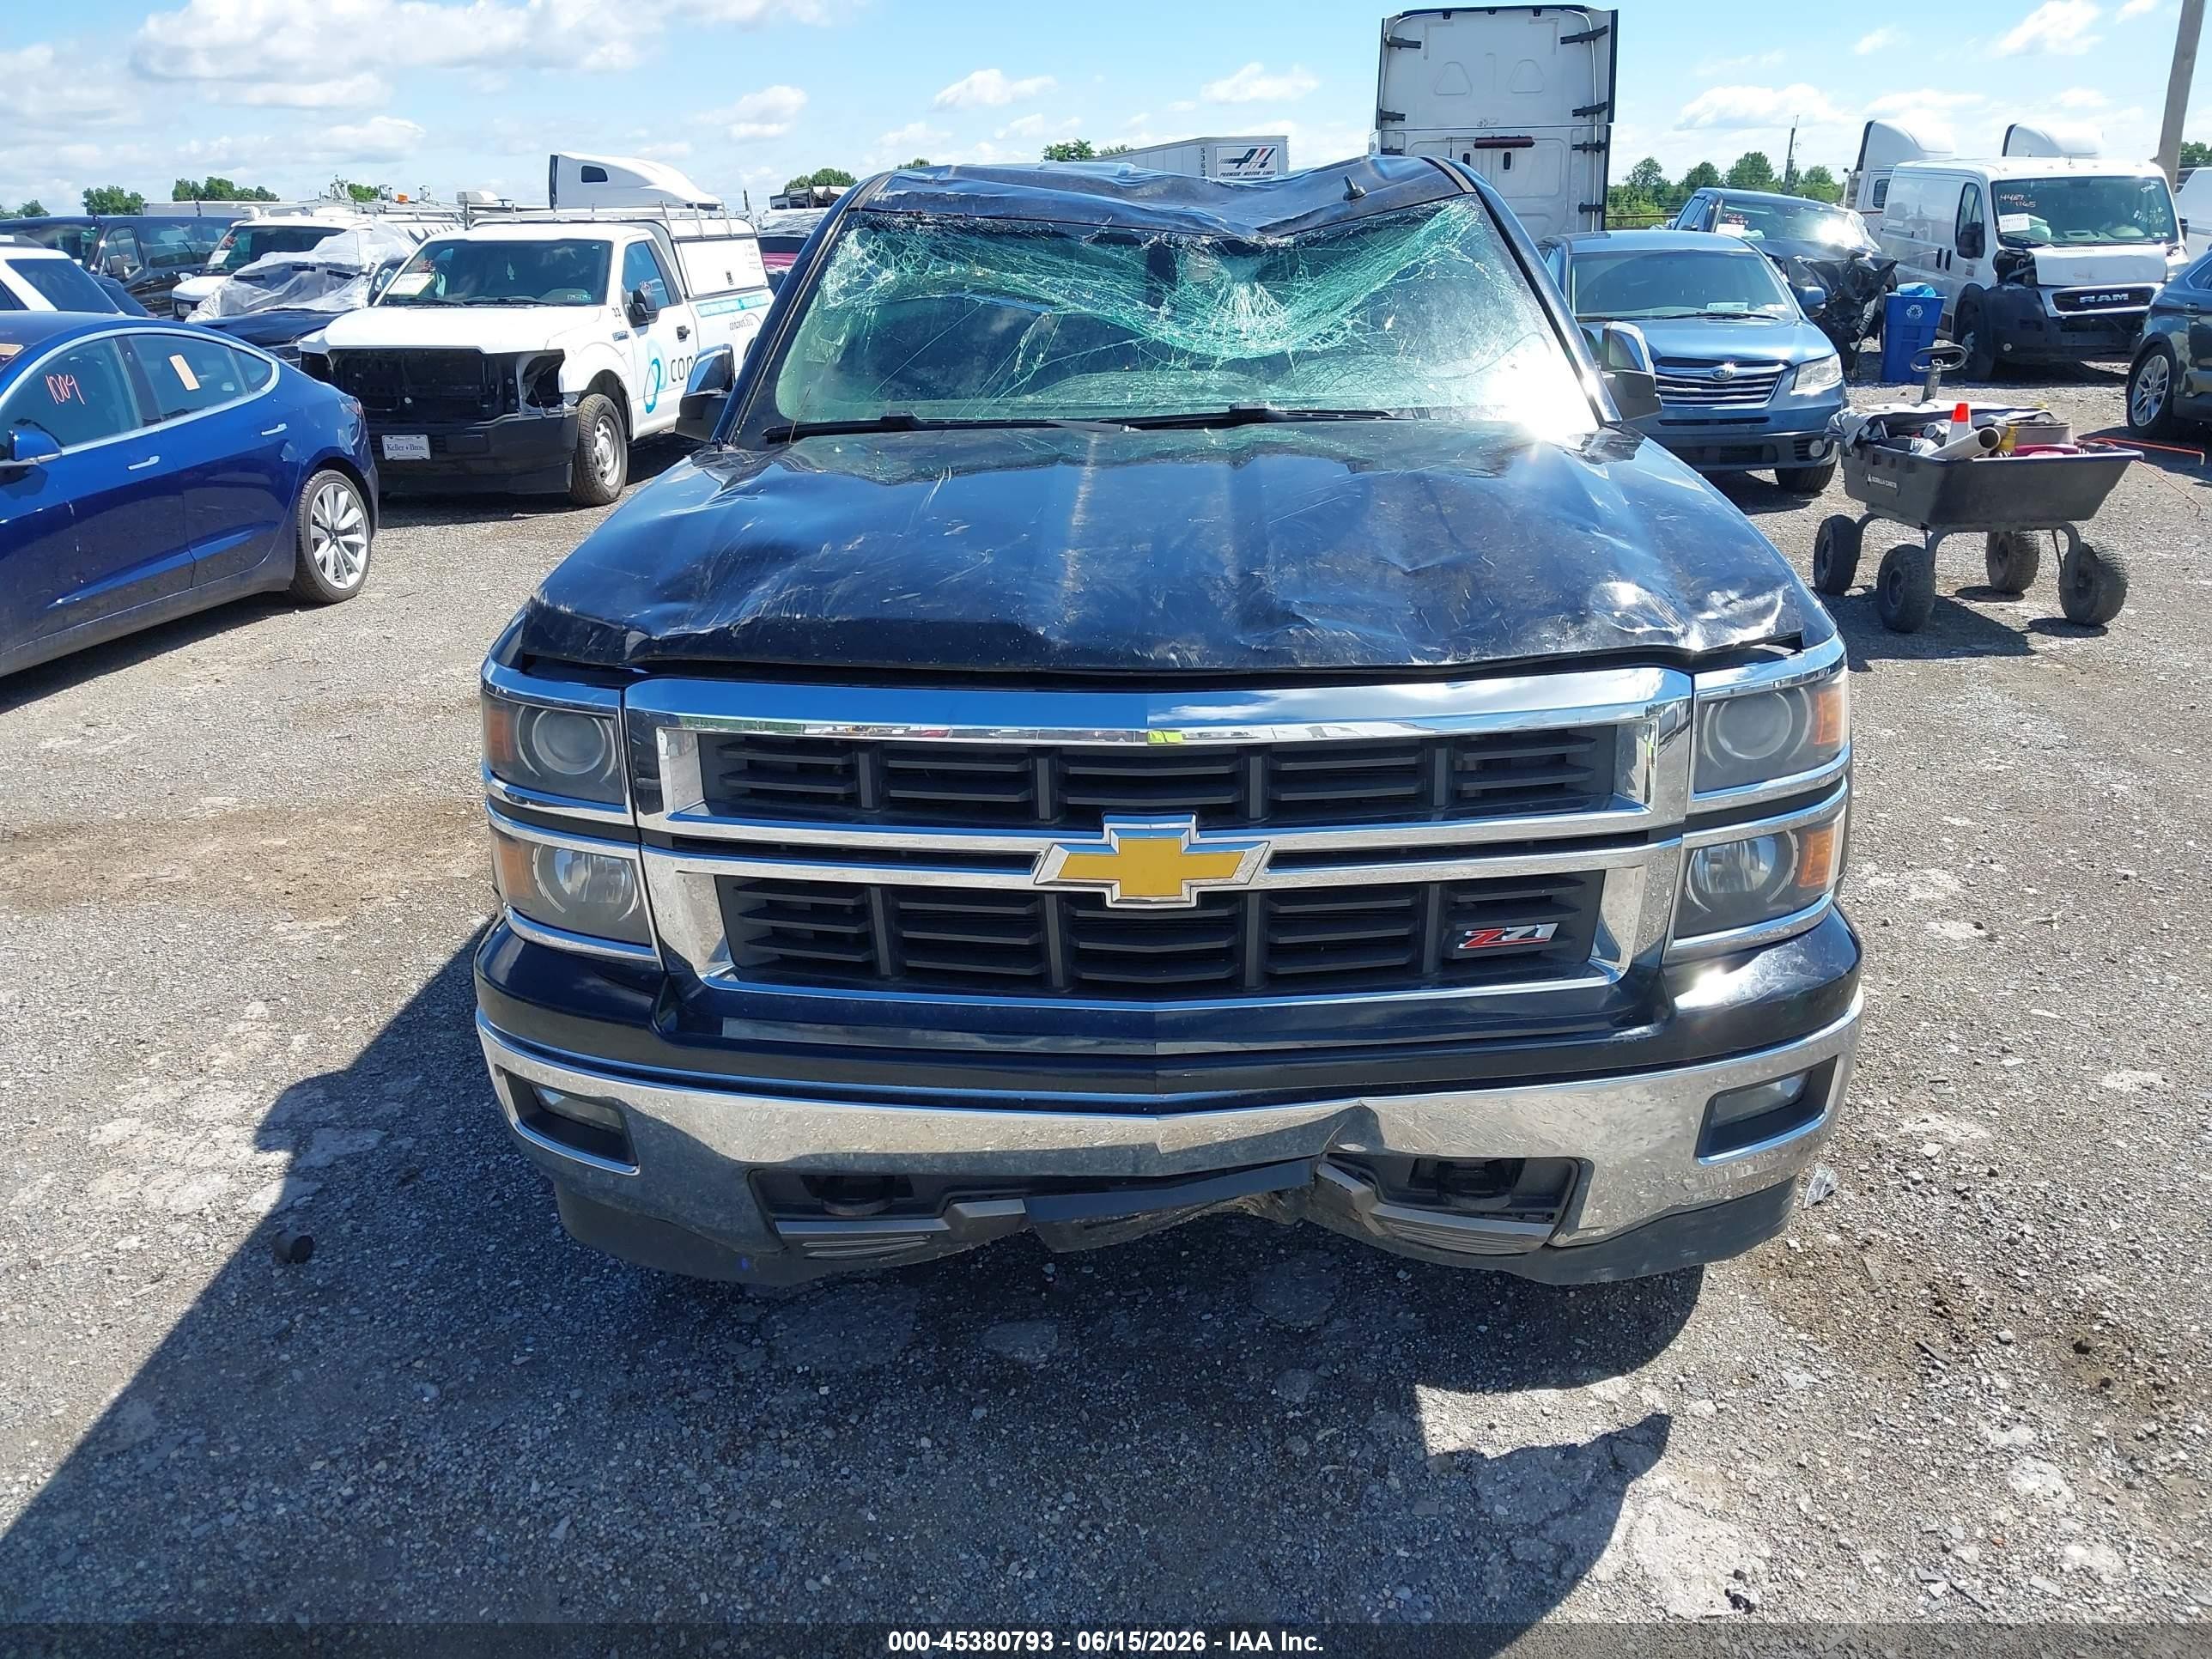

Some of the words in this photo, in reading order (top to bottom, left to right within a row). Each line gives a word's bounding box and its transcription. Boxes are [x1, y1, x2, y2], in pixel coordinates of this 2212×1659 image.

[2079, 293, 2129, 303] RAM
[386, 443, 404, 452] Keller
[1457, 923, 1559, 949] Z71
